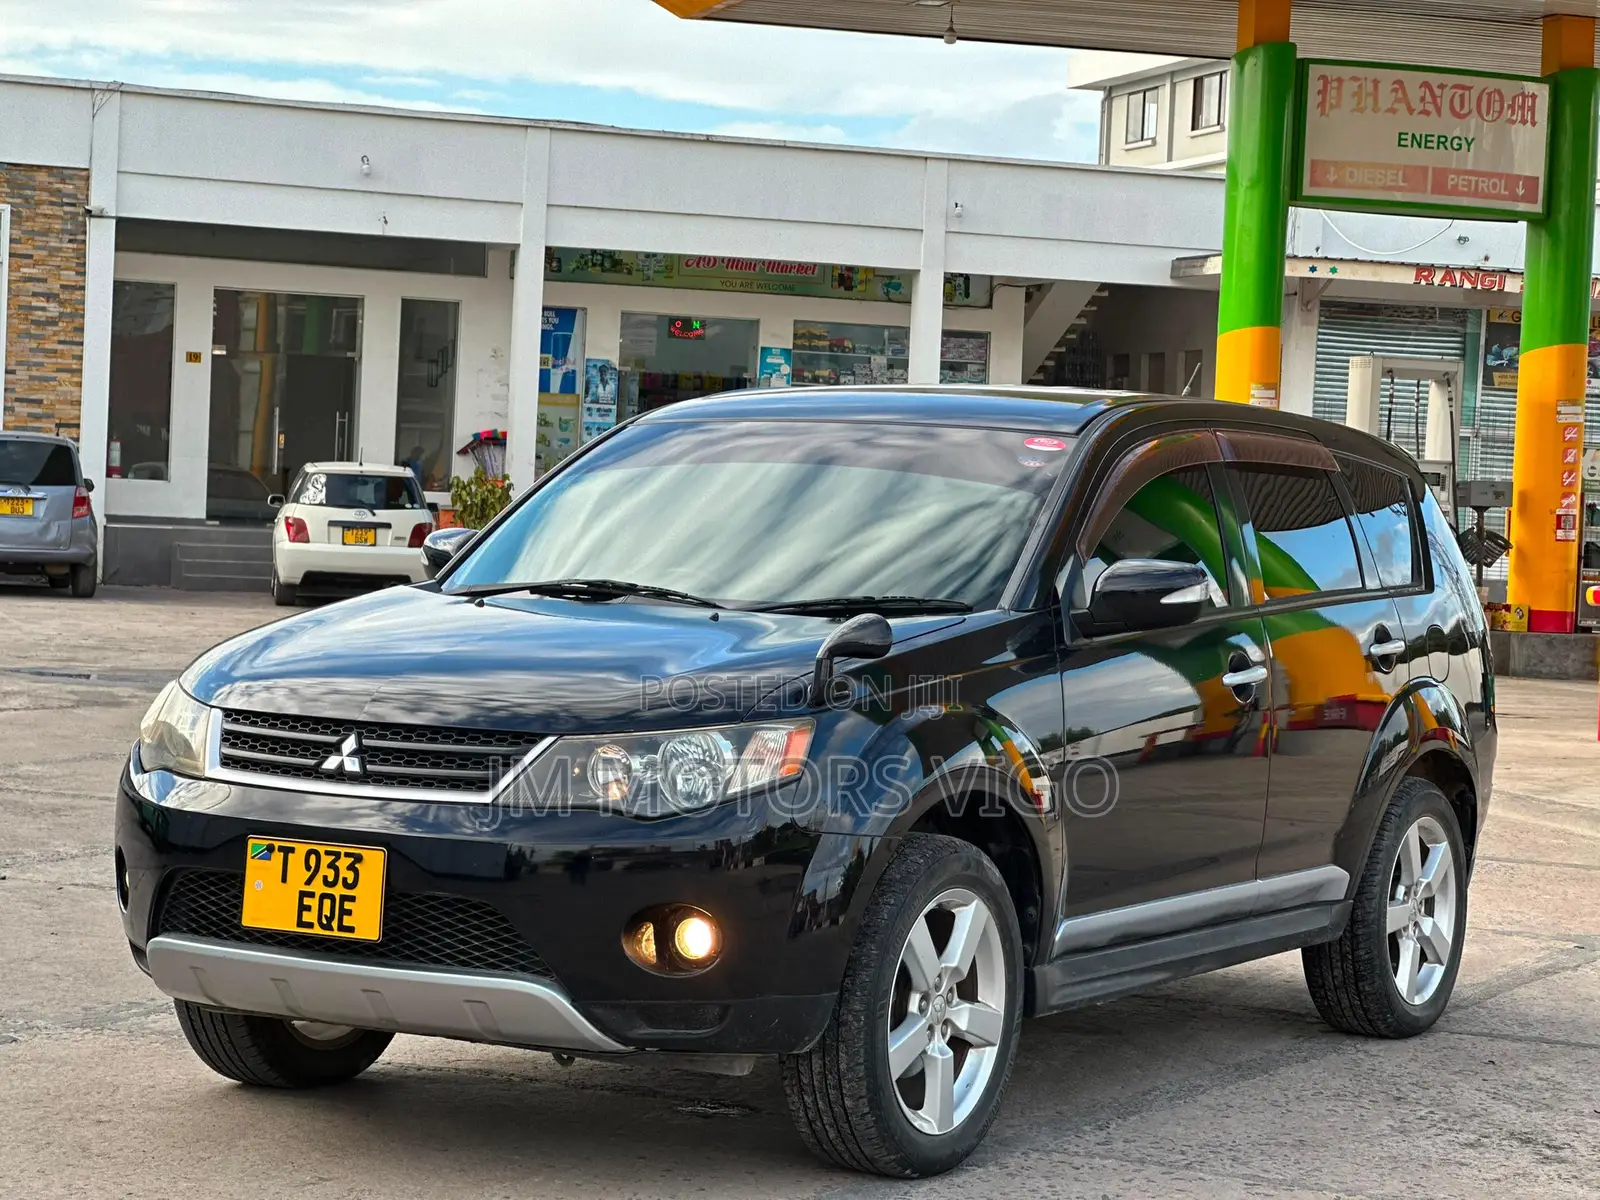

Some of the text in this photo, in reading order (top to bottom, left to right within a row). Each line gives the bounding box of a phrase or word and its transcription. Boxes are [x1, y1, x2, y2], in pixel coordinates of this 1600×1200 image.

[1316, 74, 1538, 128] PHANTOM
[1397, 132, 1475, 152] ENERGY
[1345, 166, 1407, 187] DIESEL
[1448, 174, 1509, 195] PETROL
[721, 257, 758, 272] Mini
[762, 259, 818, 276] Market
[720, 280, 796, 292] YOU ARE WELCOME
[1413, 266, 1507, 291] RANGI
[670, 325, 704, 338] WELCOME
[277, 845, 363, 890] T 933
[296, 890, 357, 933] EQE
